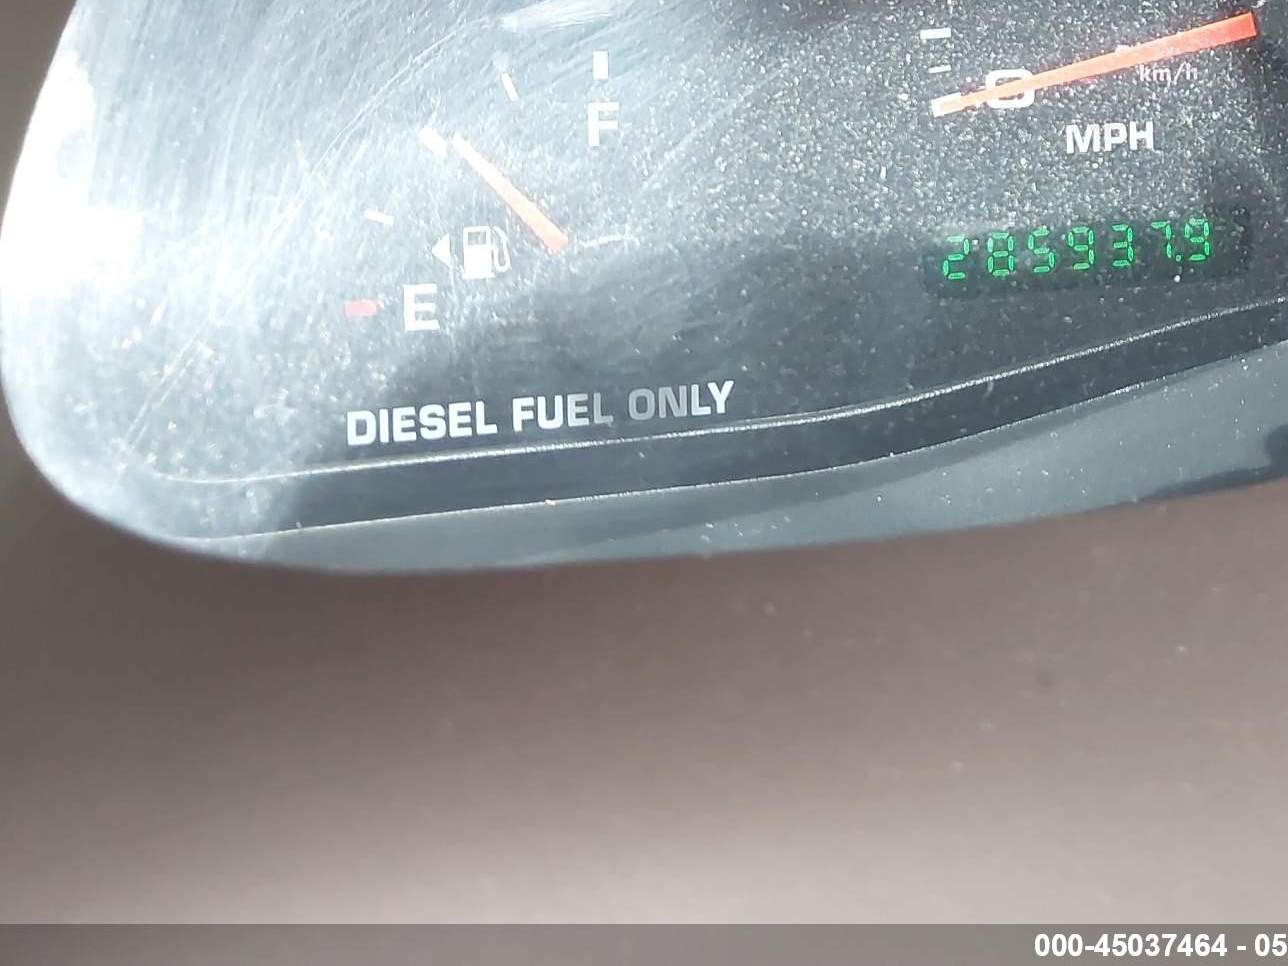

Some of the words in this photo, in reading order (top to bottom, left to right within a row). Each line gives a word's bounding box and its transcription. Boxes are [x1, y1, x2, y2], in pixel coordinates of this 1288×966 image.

[1139, 61, 1198, 86] km/h
[586, 102, 620, 147] F
[1065, 121, 1155, 154] MPH
[402, 283, 440, 332] E
[346, 401, 497, 446] DIESEL
[512, 391, 613, 432] FUEL
[627, 380, 735, 420] ONLY
